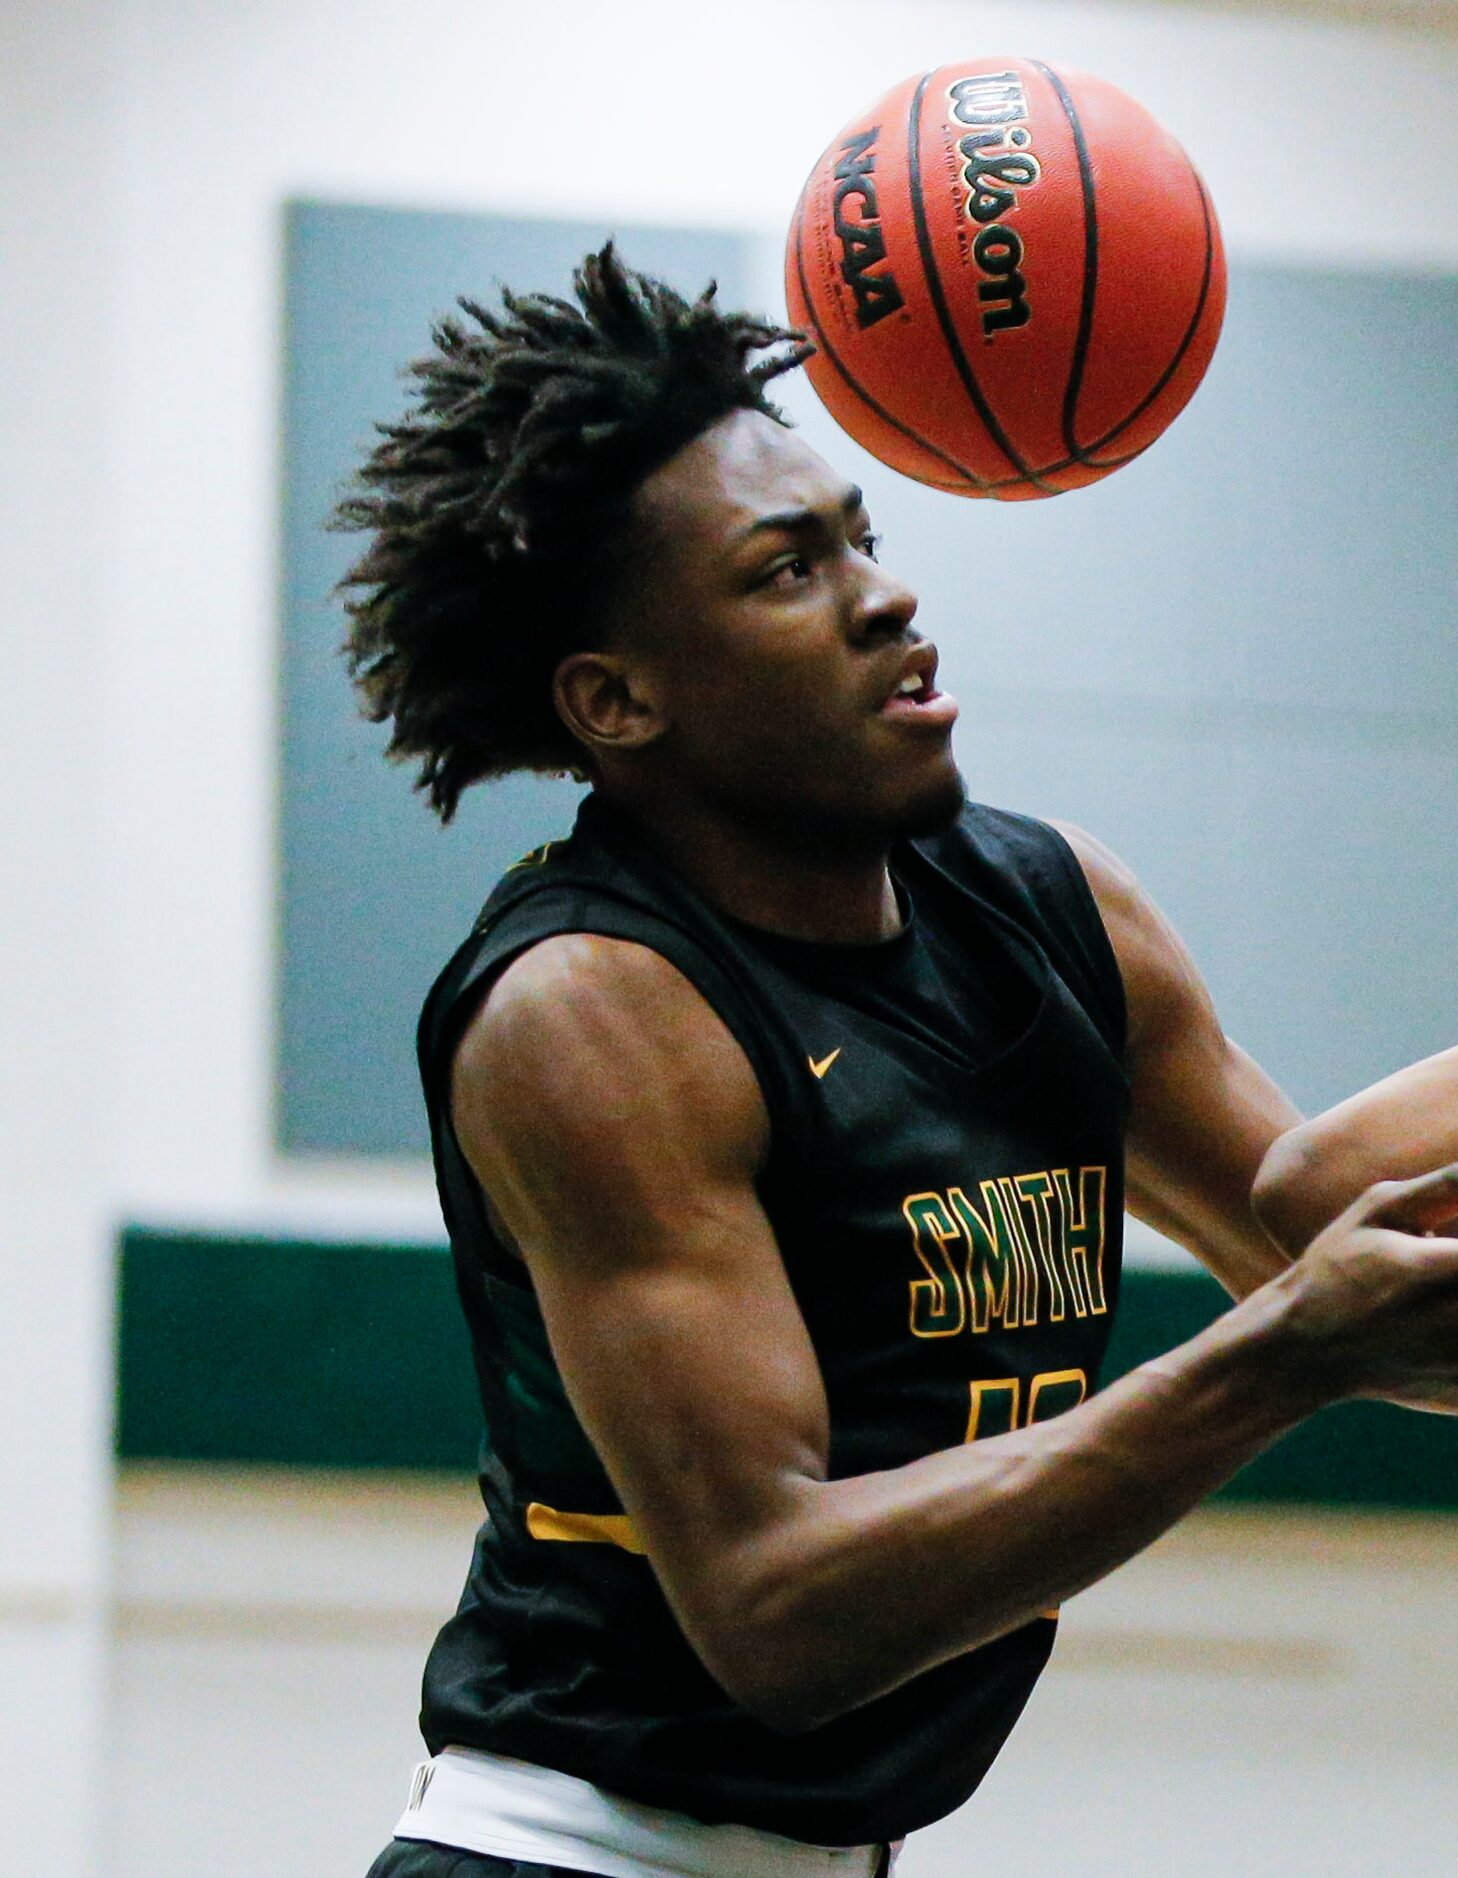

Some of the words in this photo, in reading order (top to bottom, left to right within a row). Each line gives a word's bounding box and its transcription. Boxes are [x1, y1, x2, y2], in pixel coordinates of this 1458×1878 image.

[834, 124, 907, 331] NCAA
[944, 71, 1041, 338] Wilson
[902, 1165, 1107, 1339] SMITH
